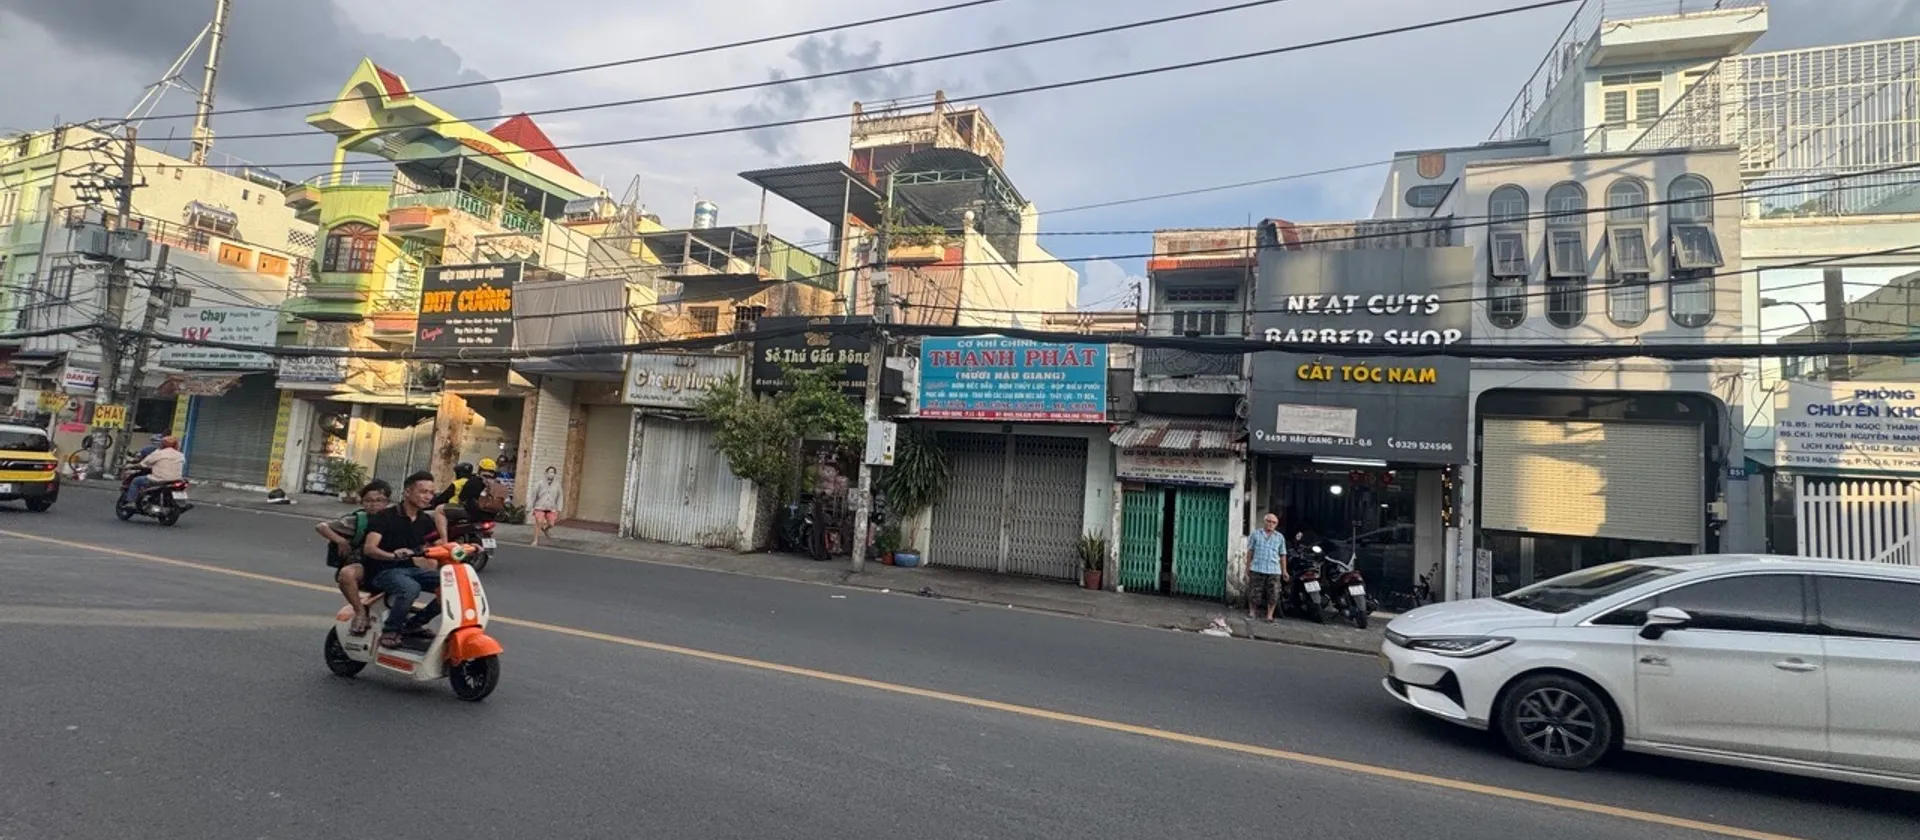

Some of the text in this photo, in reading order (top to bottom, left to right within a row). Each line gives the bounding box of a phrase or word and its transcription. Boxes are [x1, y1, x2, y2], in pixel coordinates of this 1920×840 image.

[422, 283, 511, 312] DUY CƯỜNG
[1287, 293, 1441, 315] NEAT CUTS
[200, 309, 228, 324] Chay
[956, 338, 974, 348] CƠ
[976, 338, 998, 348] KHÍ
[1264, 328, 1463, 345] BARBER SHOP
[764, 347, 870, 367] Sở Thú Gấu Bông
[928, 344, 1099, 371] THẠNH PHÁT
[1296, 356, 1437, 384] CẮT TÓC NAM
[1853, 386, 1916, 400] PHÒNG
[96, 406, 124, 419] CHAY
[1806, 402, 1880, 418] CHUYÊN
[1308, 436, 1333, 444] GIANG
[1396, 442, 1418, 450] 0329
[1801, 442, 1822, 451] LỊCH
